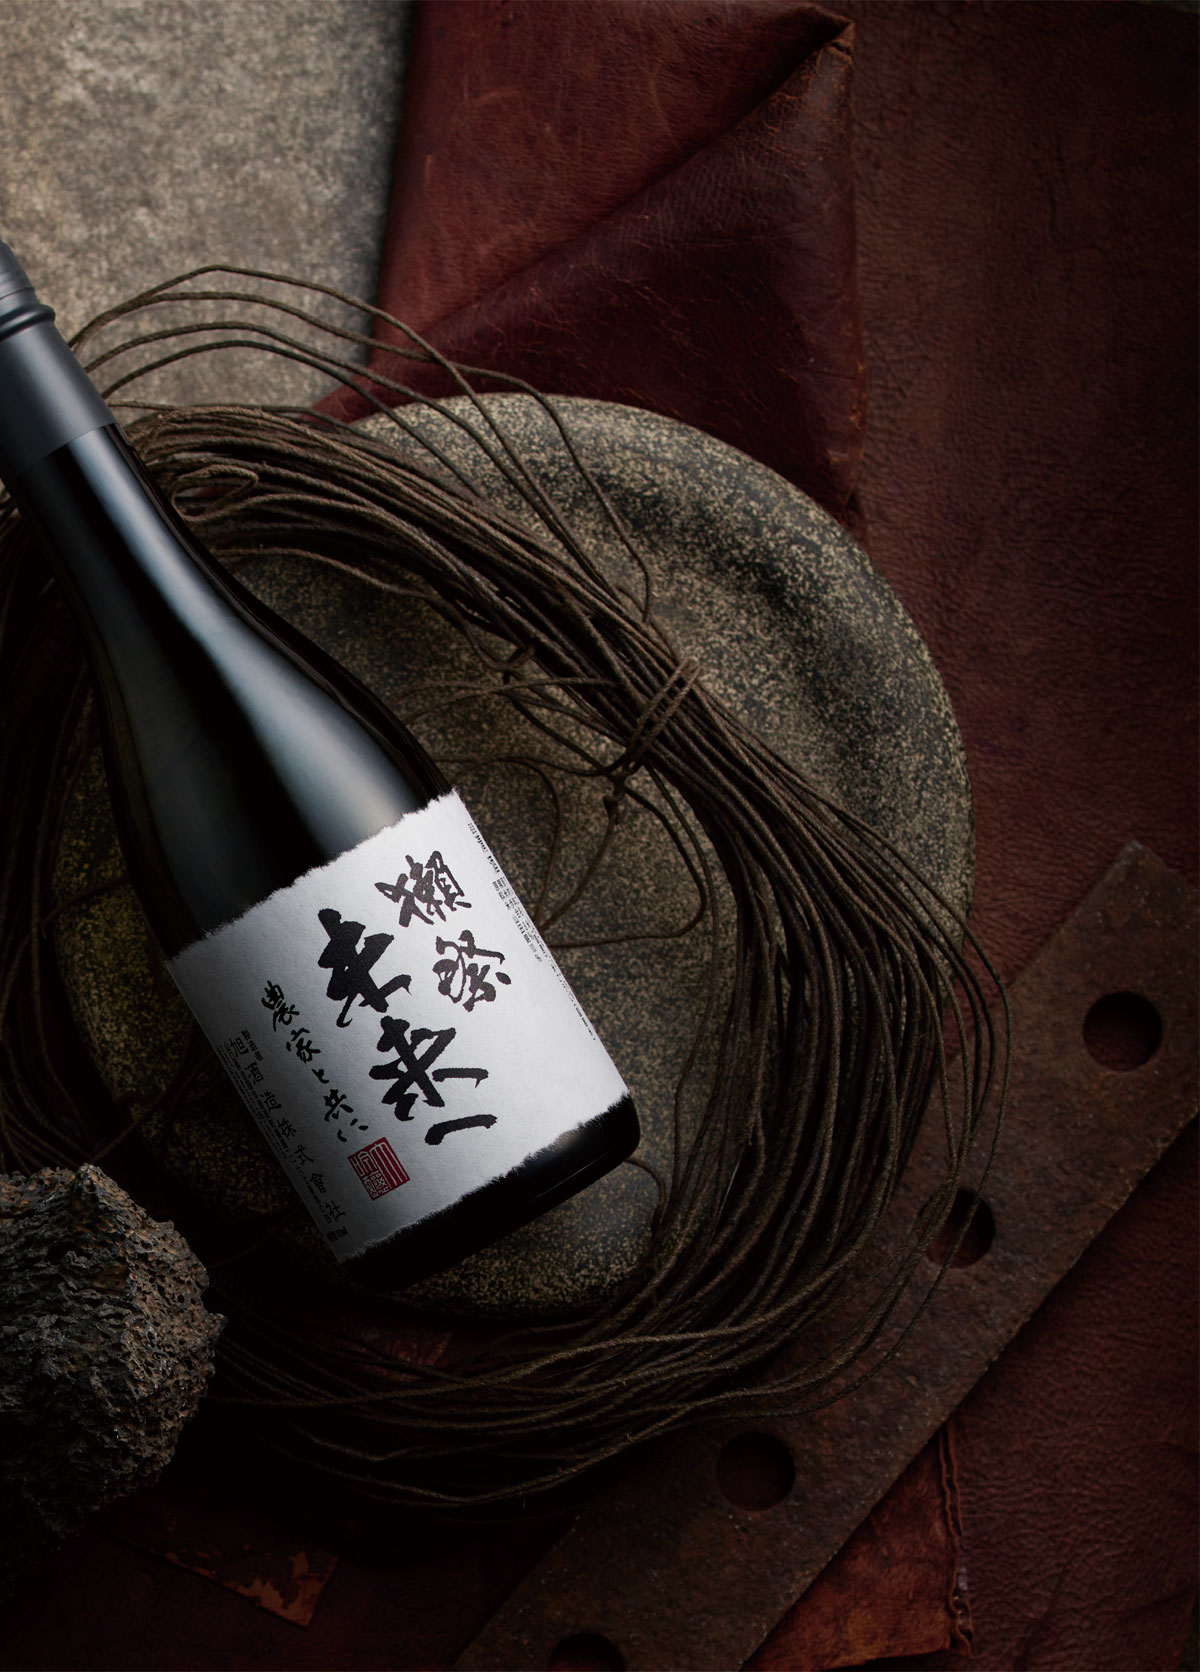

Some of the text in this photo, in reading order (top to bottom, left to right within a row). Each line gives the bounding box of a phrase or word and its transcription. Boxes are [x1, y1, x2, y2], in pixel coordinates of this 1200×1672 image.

[374, 850, 511, 1012] 獺祭
[261, 980, 369, 1142] 農家と共に
[318, 908, 498, 1145] 未来へ
